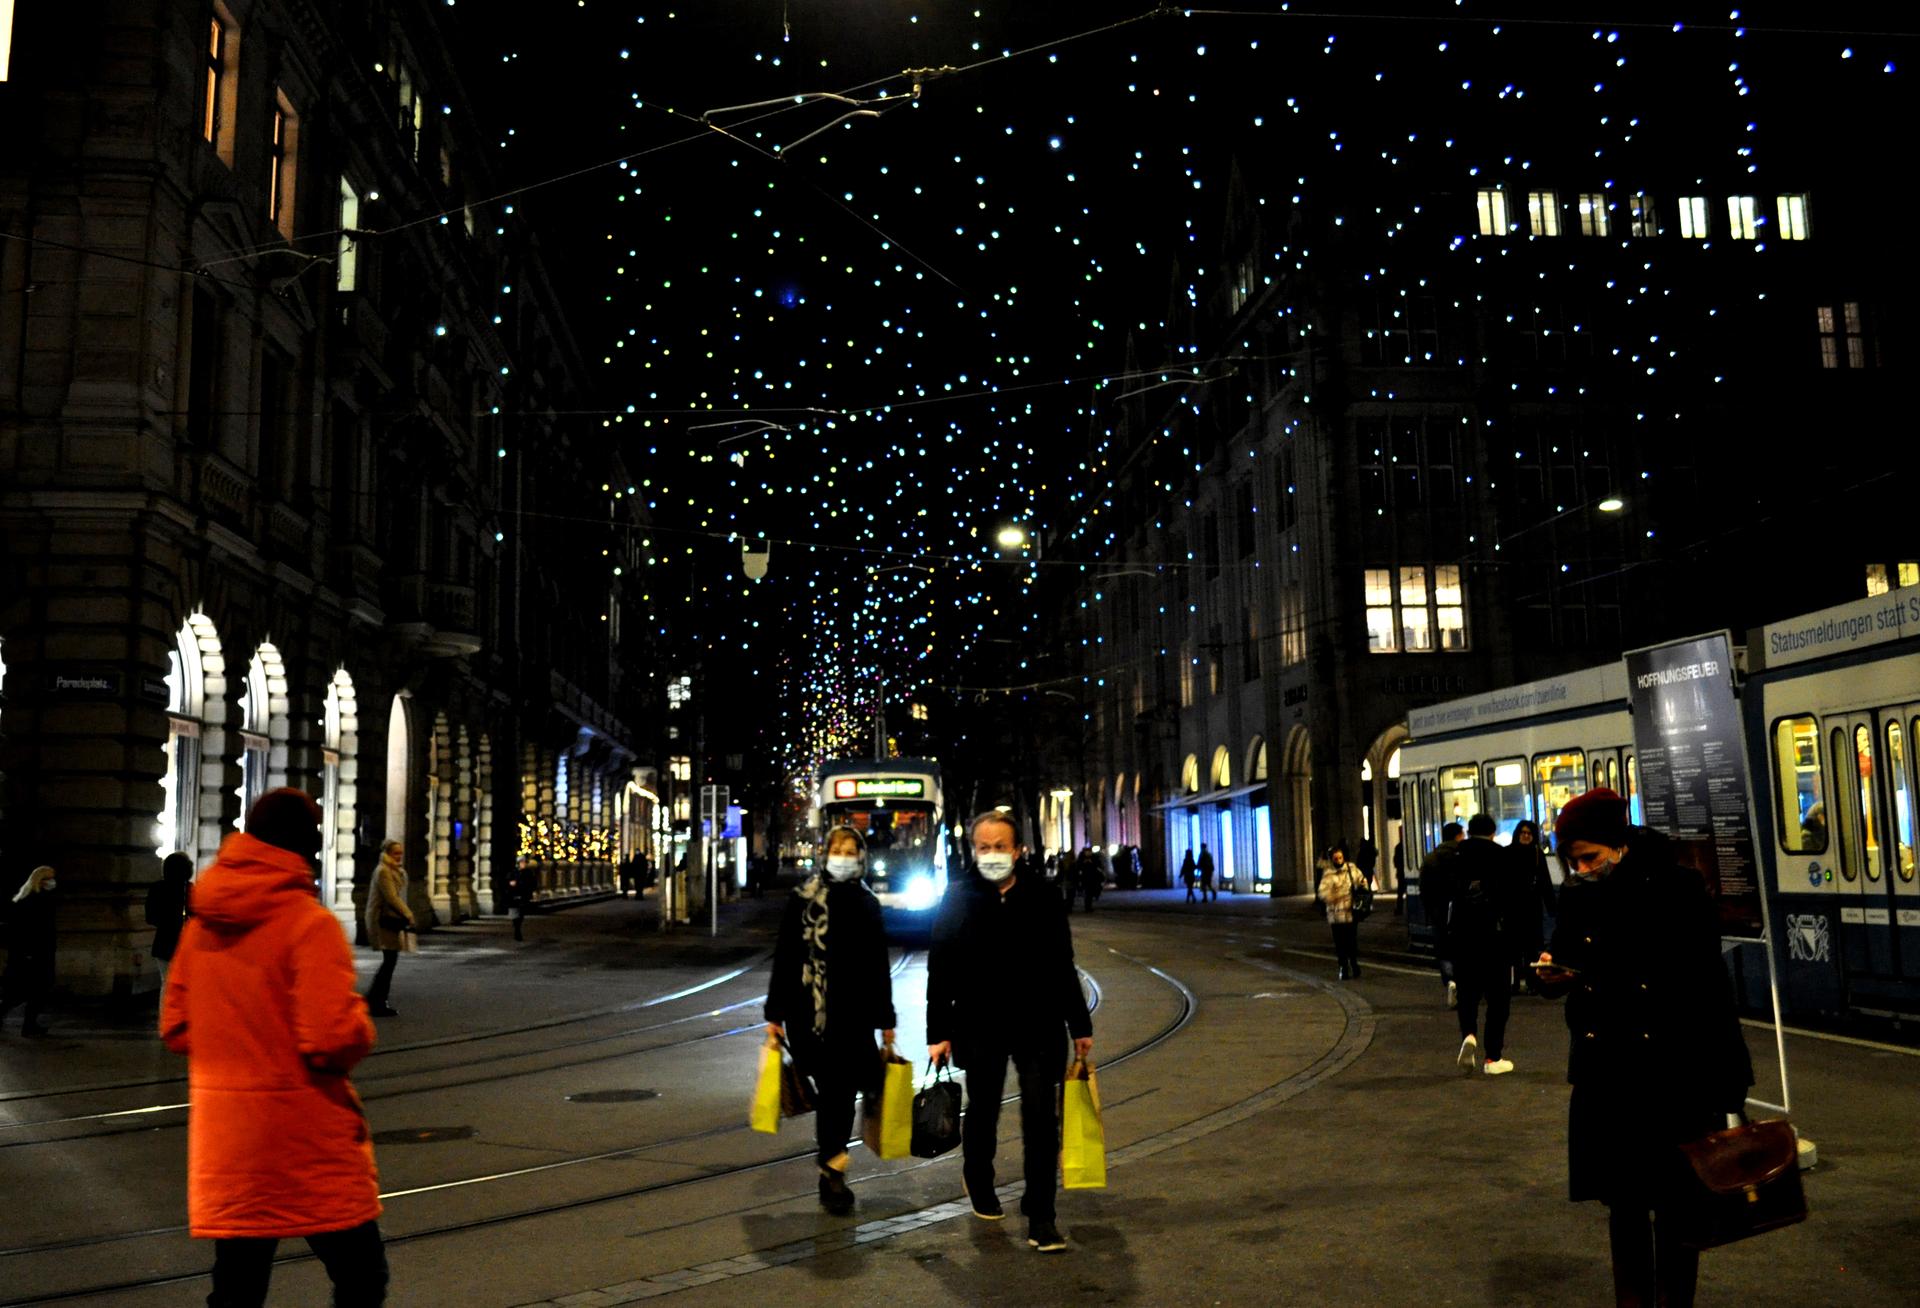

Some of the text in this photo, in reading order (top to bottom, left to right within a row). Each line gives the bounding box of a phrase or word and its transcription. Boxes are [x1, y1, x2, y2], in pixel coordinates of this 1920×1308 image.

[1771, 614, 1873, 655] Statusmeldungen
[1877, 602, 1906, 630] statt
[1637, 661, 1720, 689] HOFFNUNGSFEUER
